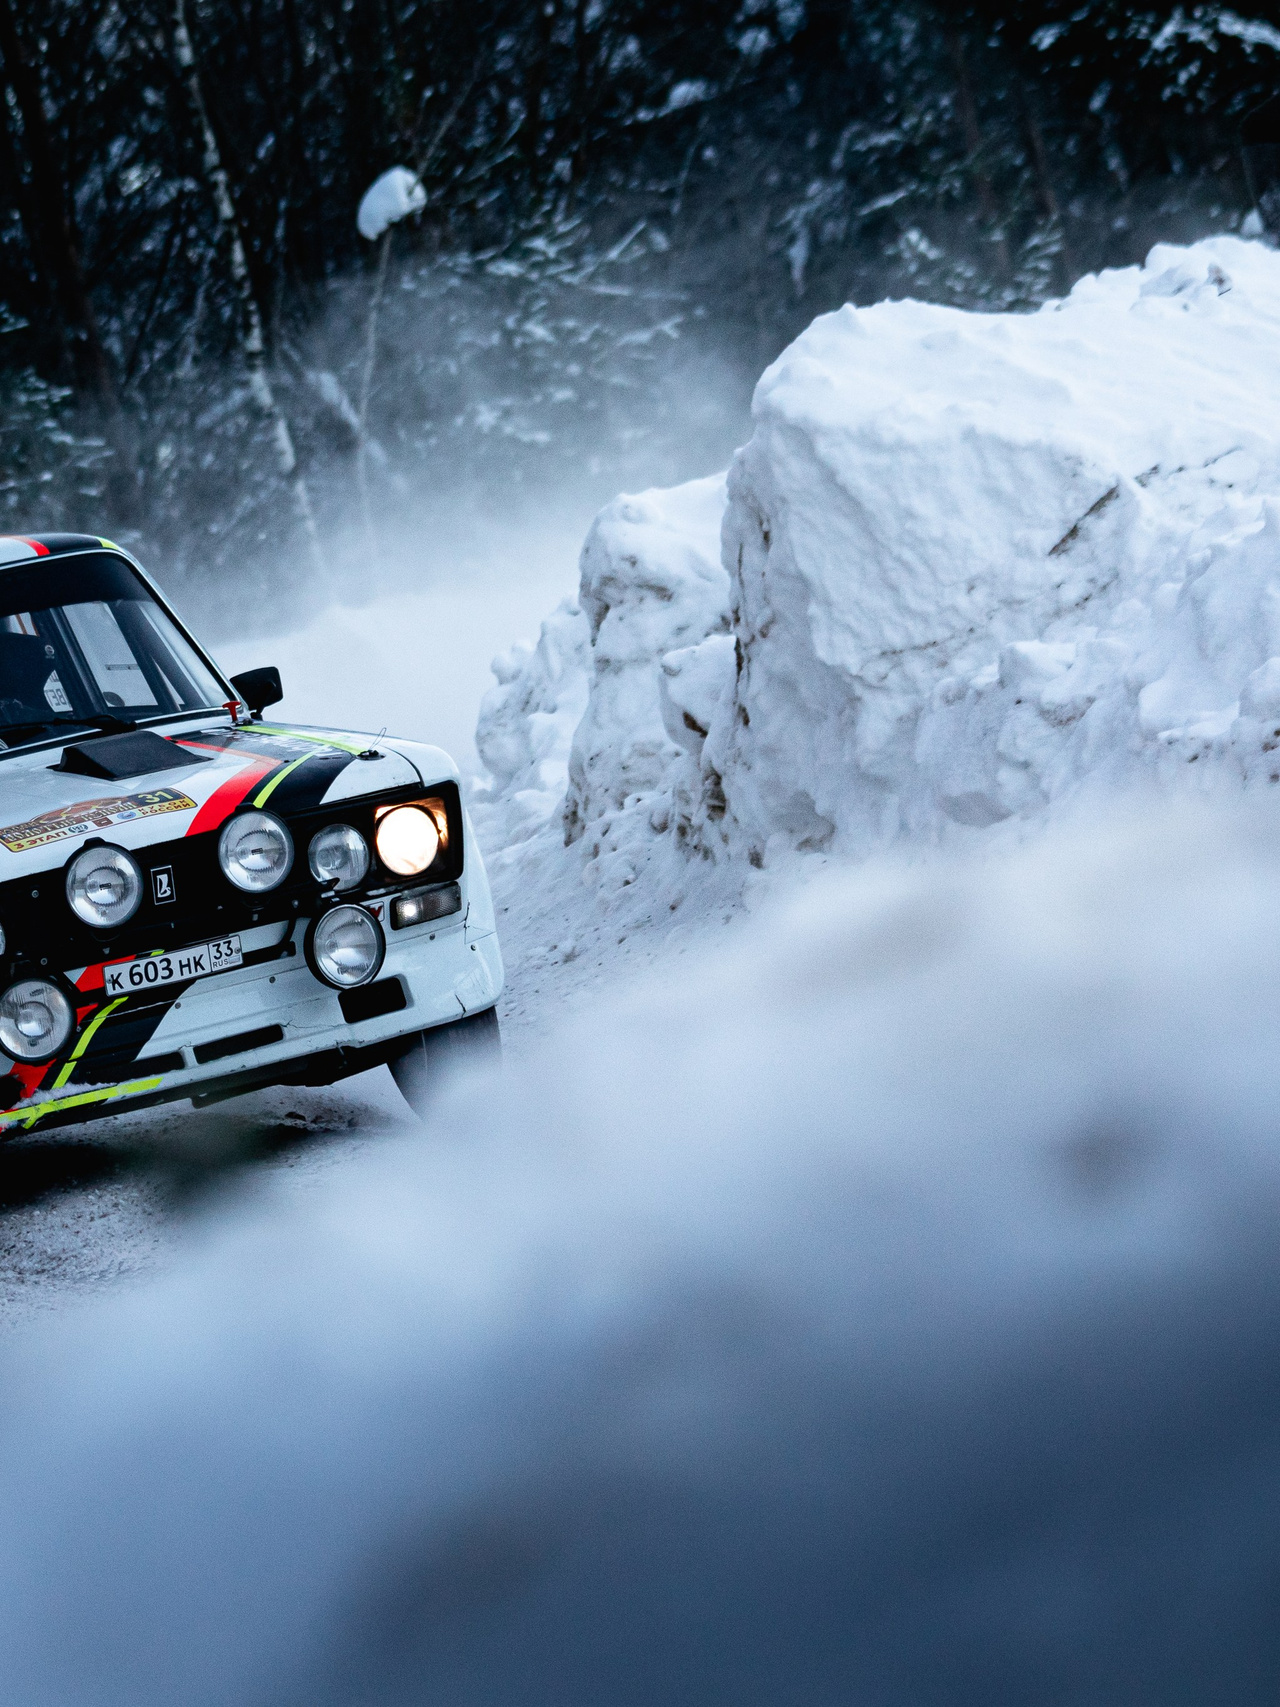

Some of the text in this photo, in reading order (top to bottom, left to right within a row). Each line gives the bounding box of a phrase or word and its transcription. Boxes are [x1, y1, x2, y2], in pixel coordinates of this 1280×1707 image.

[138, 791, 174, 803] 31
[138, 799, 187, 812] КУБОК
[142, 803, 191, 815] РОССИИ
[26, 830, 68, 846] ЭТАП
[110, 940, 234, 991] К 603 НК 33
[213, 959, 229, 969] RUS
